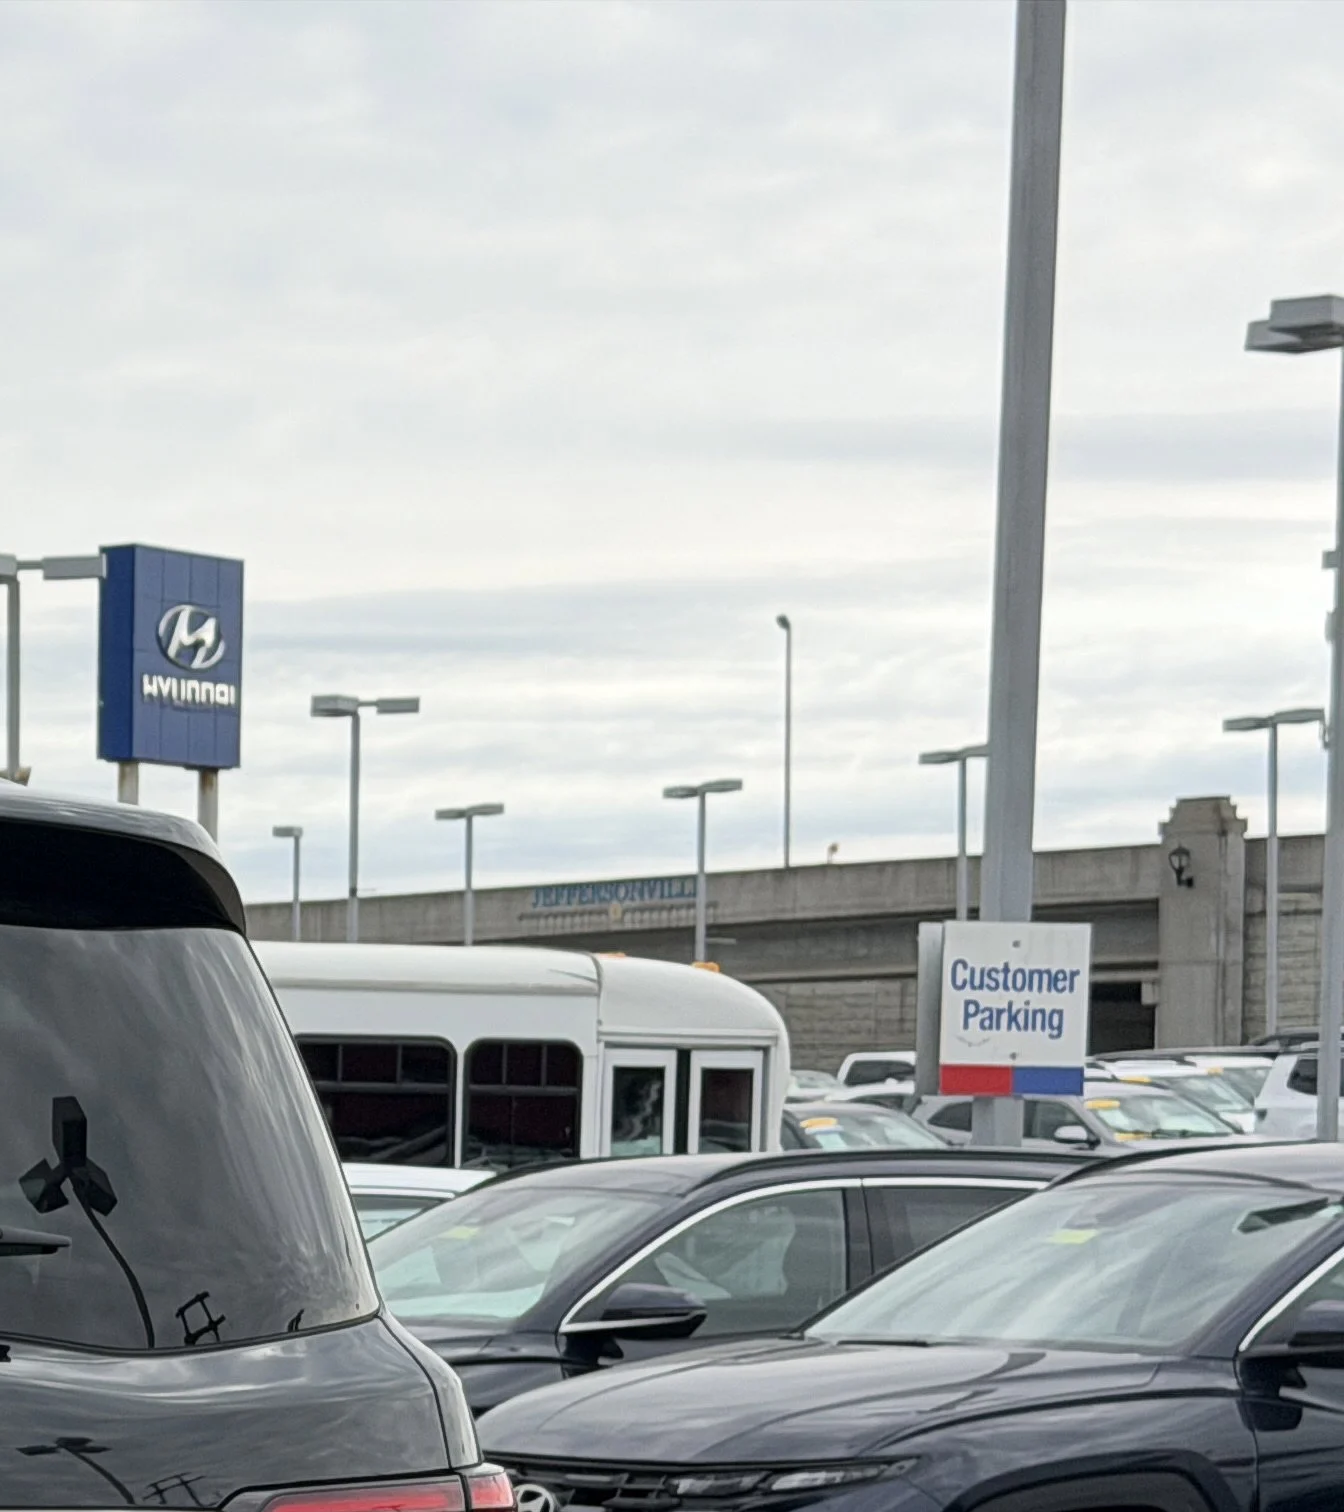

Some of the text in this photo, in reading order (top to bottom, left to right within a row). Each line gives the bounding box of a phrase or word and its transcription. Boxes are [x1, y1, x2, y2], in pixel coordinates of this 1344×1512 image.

[142, 673, 236, 706] HYUNDAI
[532, 876, 698, 909] JEFFERSONVILL
[950, 958, 1080, 994] Customer
[962, 999, 1065, 1040] Parking
